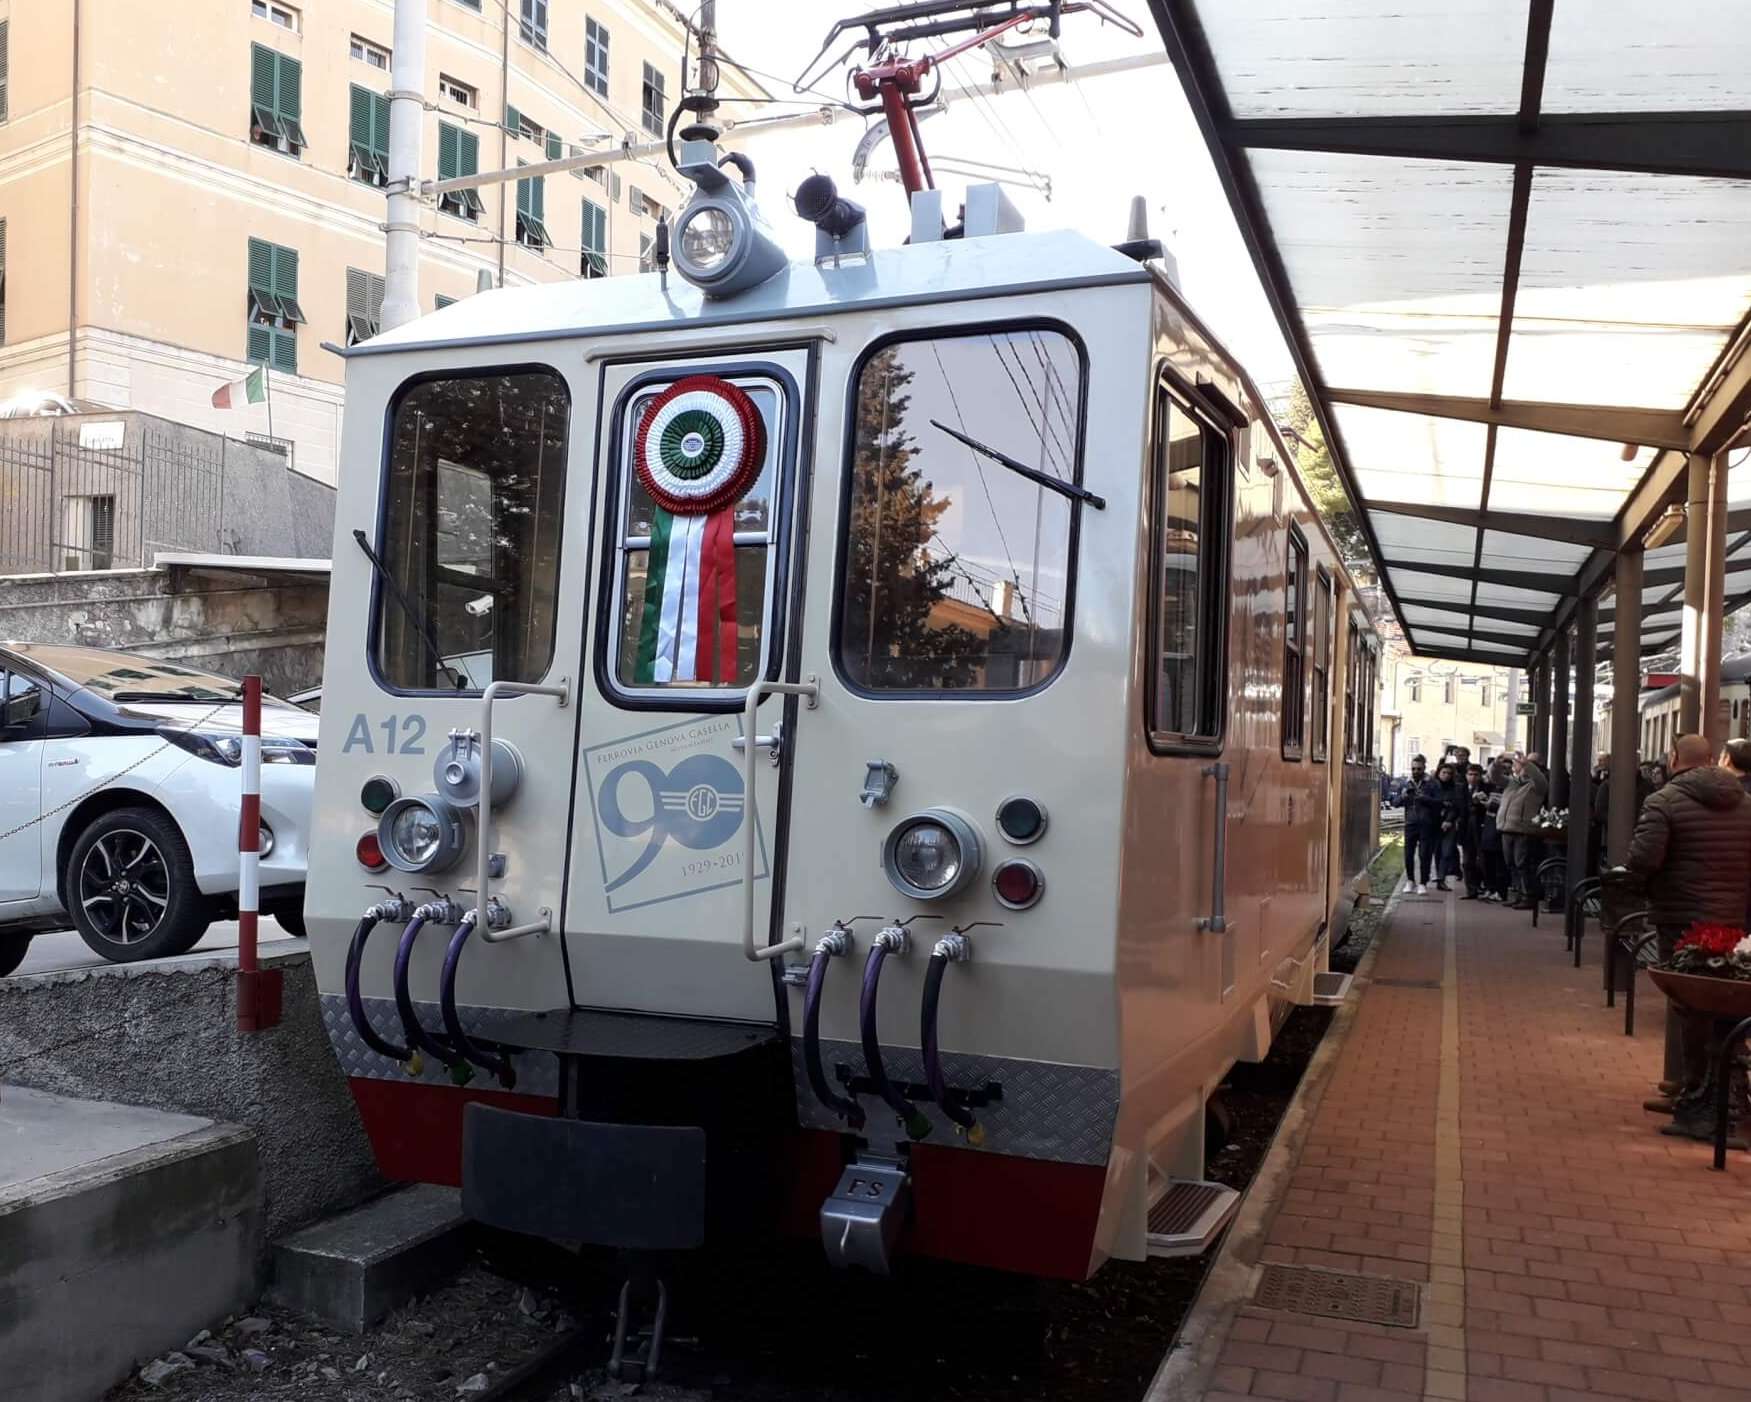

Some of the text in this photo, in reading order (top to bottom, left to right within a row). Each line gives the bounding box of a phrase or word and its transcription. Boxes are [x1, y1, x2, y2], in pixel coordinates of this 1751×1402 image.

[597, 746, 643, 763] FERROVIA
[646, 733, 686, 751] GENOVA
[688, 721, 731, 738] CASELLA
[597, 753, 745, 893] 90
[680, 851, 744, 877] 1929-201
